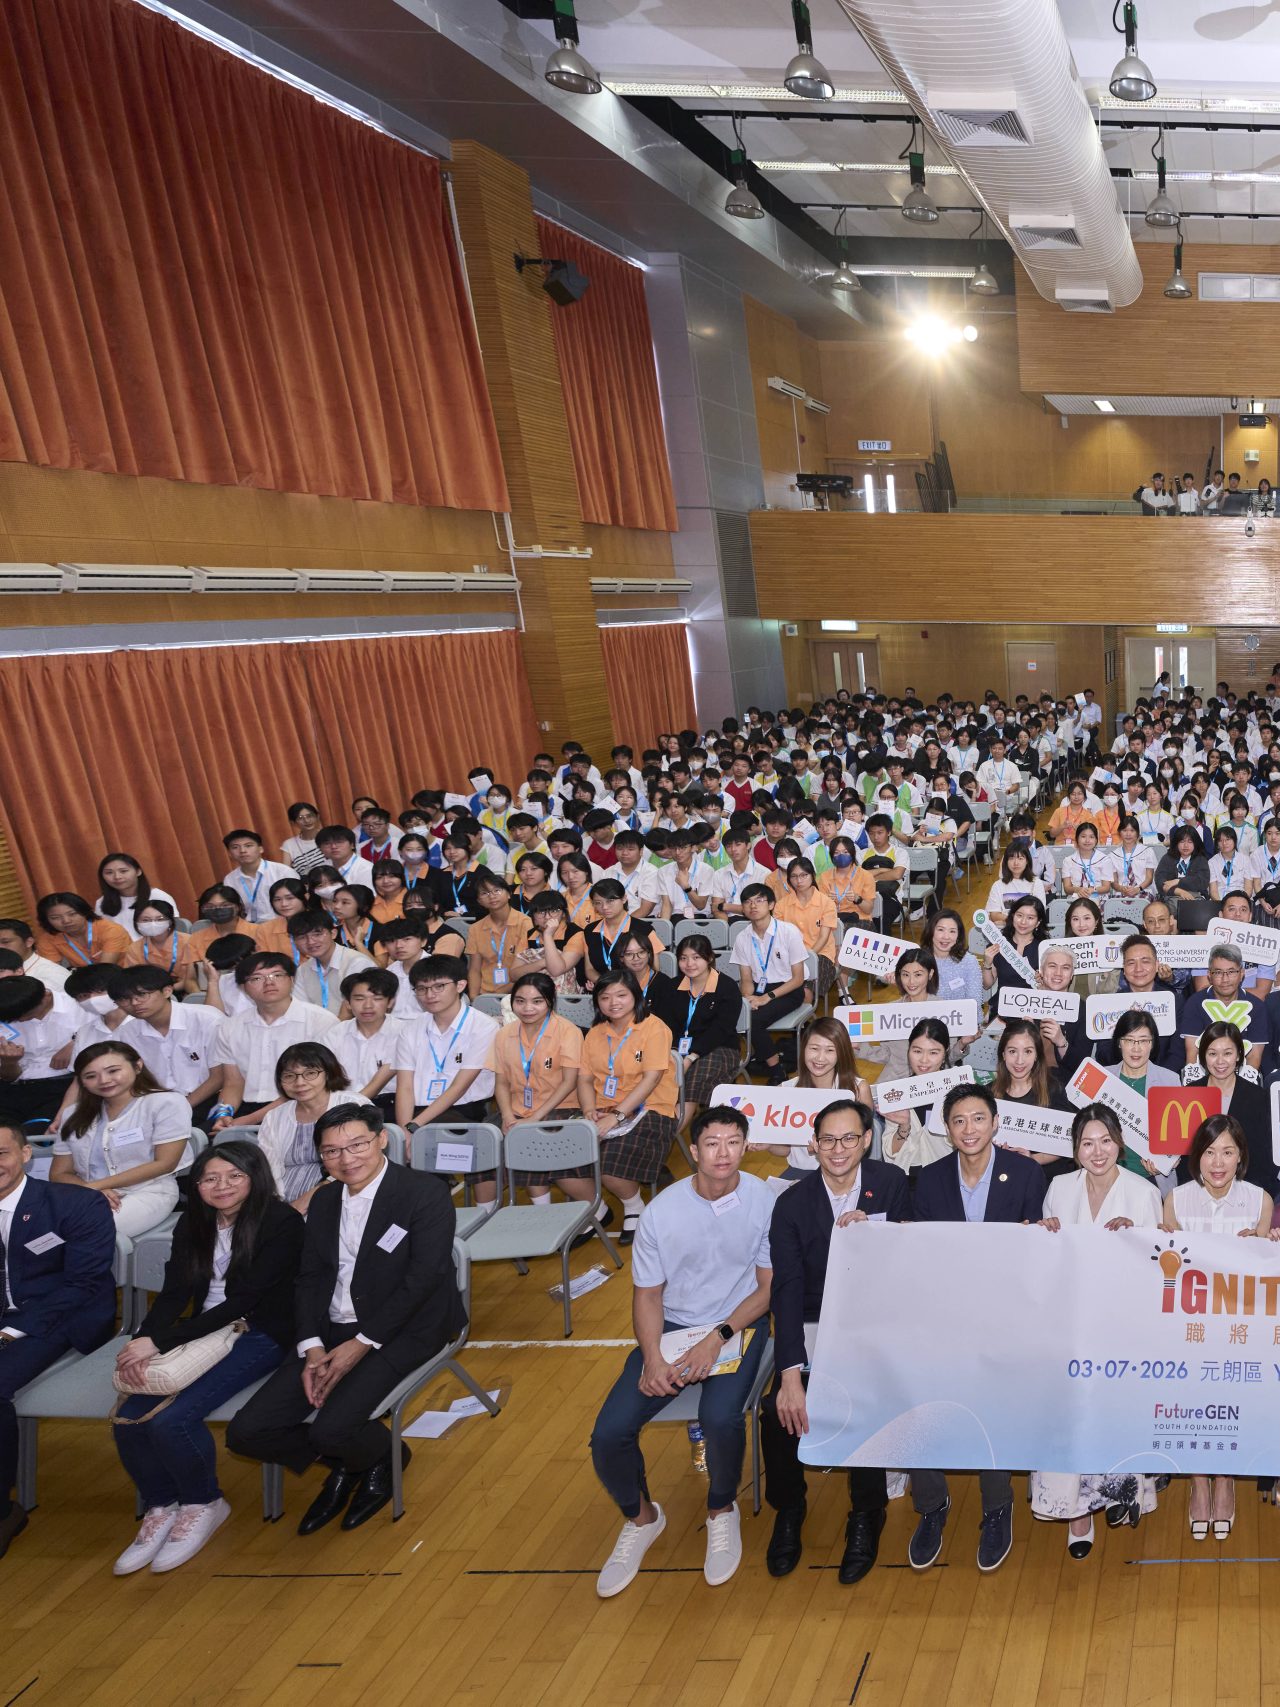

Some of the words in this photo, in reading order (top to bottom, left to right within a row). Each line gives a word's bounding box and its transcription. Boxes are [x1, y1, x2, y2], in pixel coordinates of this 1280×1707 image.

[1236, 931, 1278, 949] shtm
[845, 947, 894, 965] DALLOY
[880, 1010, 963, 1030] Microft
[764, 1104, 816, 1129] klo
[1200, 1360, 1262, 1382] 元朗區
[1154, 1403, 1239, 1420] FutureGEN
